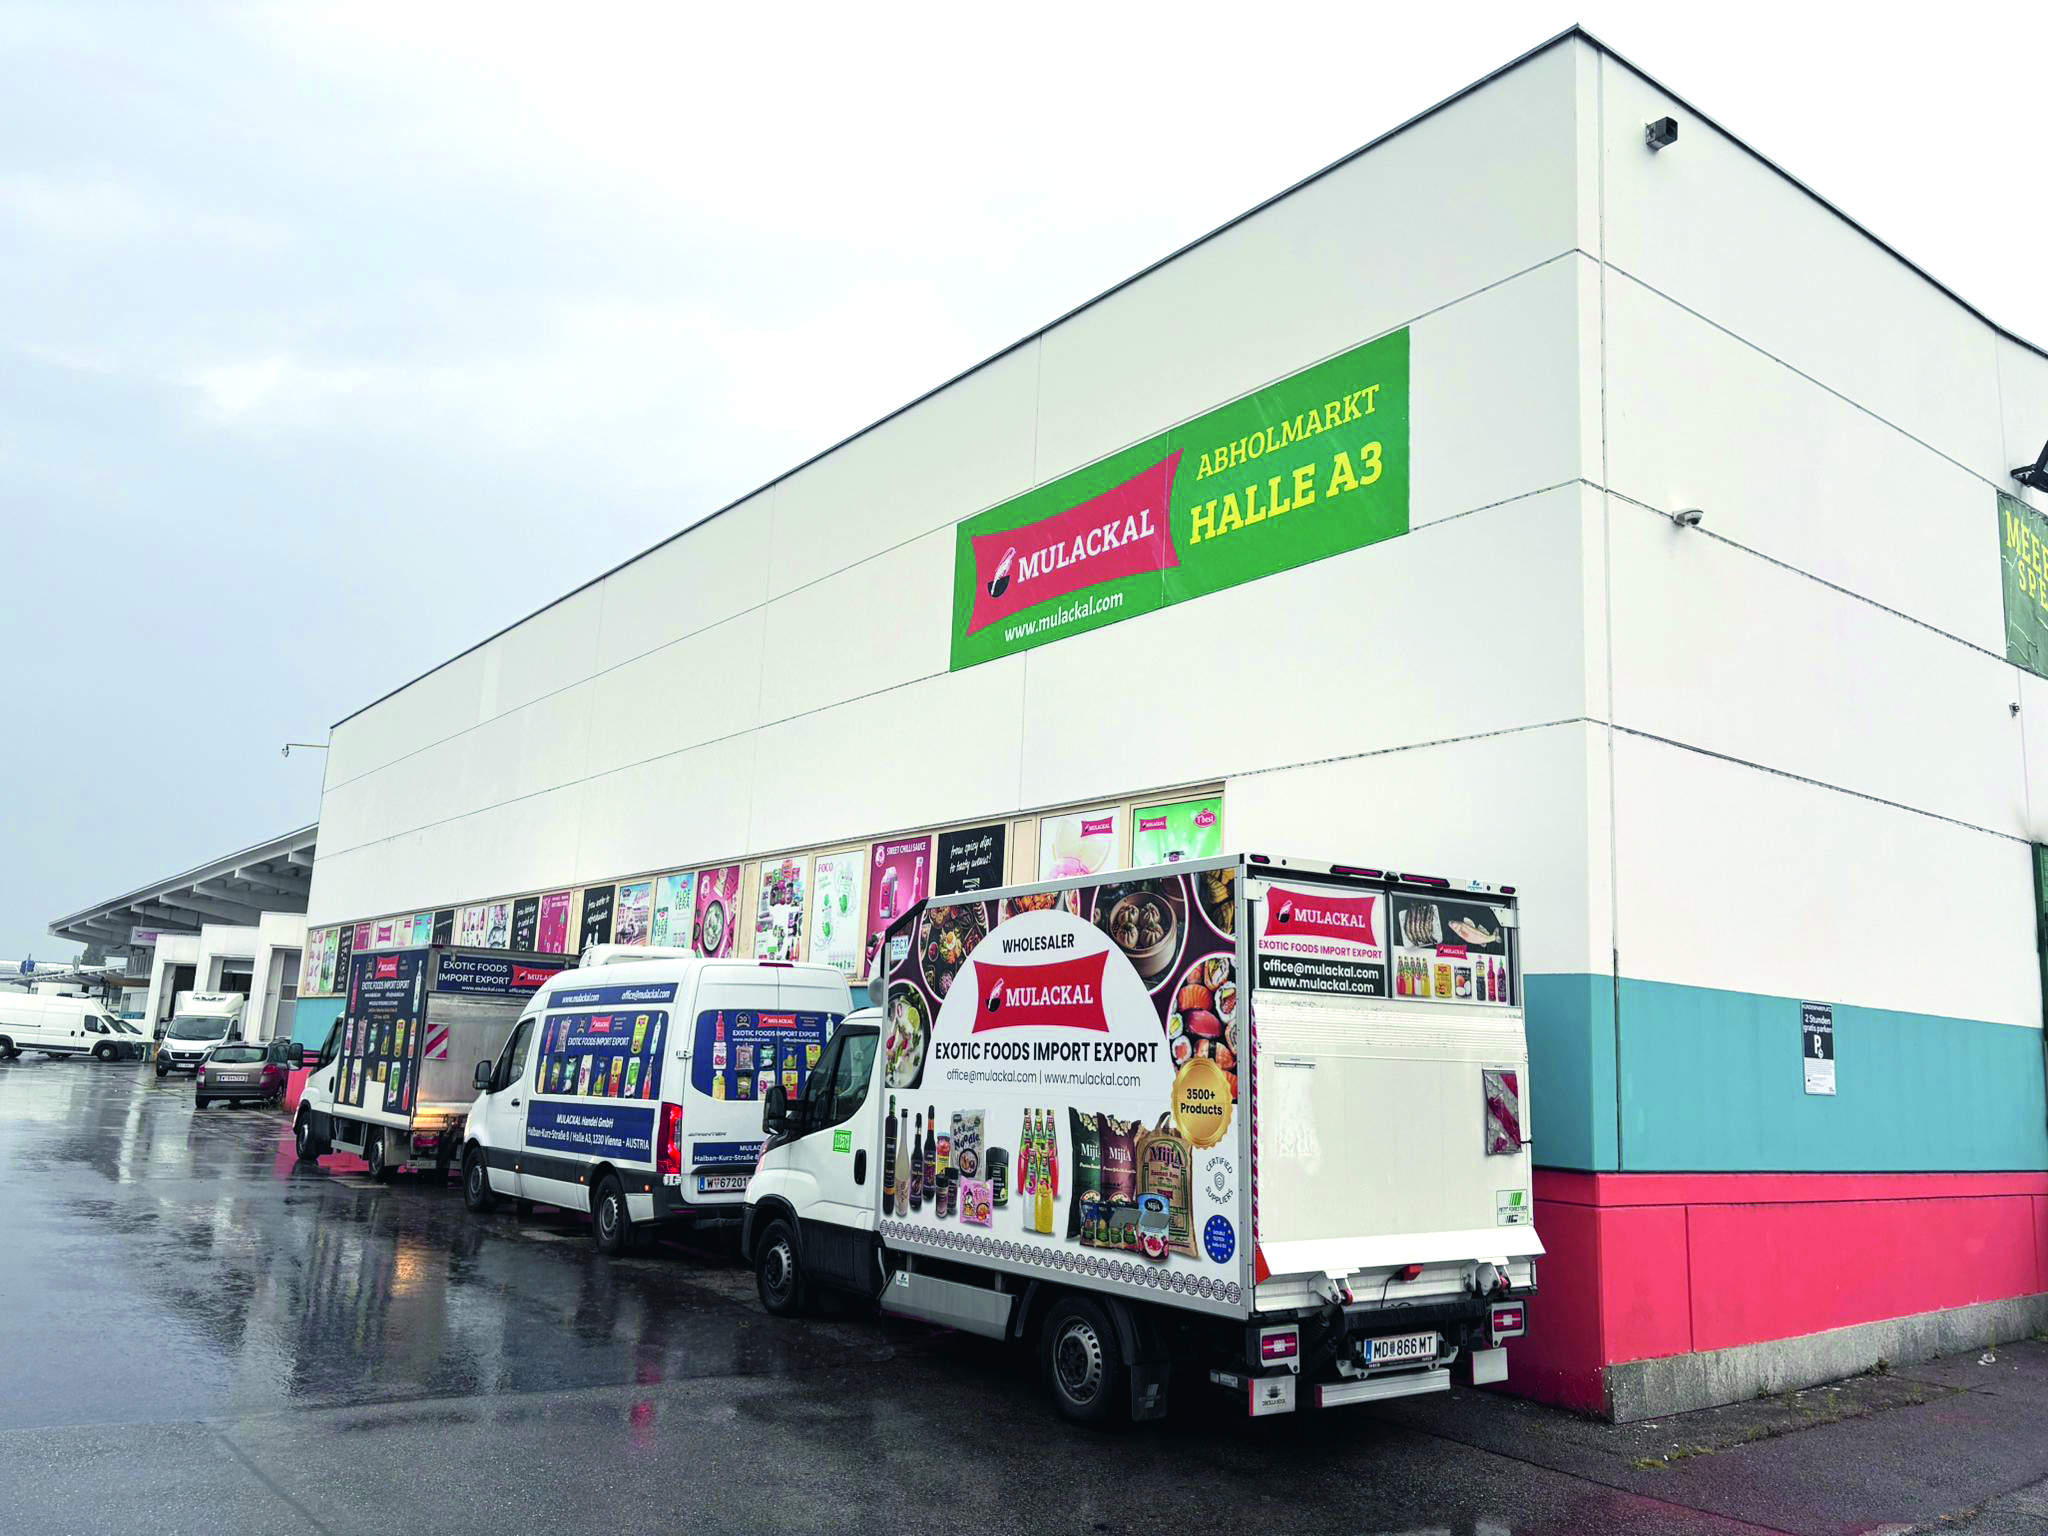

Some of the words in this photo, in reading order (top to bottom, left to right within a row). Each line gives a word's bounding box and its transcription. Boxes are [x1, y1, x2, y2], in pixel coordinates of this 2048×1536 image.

[1196, 384, 1379, 480] ABHOLMARKT
[1190, 467, 1315, 545] HALLE
[1326, 441, 1383, 498] A3
[1017, 509, 1154, 584] MULACKAL
[1004, 592, 1123, 642] www.mulackal.com
[887, 846, 899, 855] SWEET
[913, 842, 926, 851] SAUCE
[1294, 908, 1366, 928] MULACKAL
[1003, 934, 1075, 953] WHOLESALER
[1259, 940, 1289, 951] EXOTIC
[1291, 943, 1319, 954] FOODS
[1320, 945, 1350, 956] IMPORT
[1352, 948, 1382, 959] EXPORT
[443, 960, 476, 971] EXOTIC
[477, 963, 508, 973] FOODS
[1263, 959, 1379, 979] office@mulackal.com
[439, 973, 474, 983] IMPORT
[476, 975, 509, 985] EXPORT
[1269, 976, 1374, 993] www.mulackal.com
[1006, 984, 1093, 1007] MULACKAL
[1805, 1014, 1809, 1023] 2
[1809, 1014, 1831, 1025] Stunden
[1803, 1025, 1816, 1033] gratis
[1817, 1026, 1832, 1034] parken
[612, 1037, 630, 1045] EXPORT
[1813, 1034, 1822, 1054] P
[935, 1043, 981, 1060] EXOTIC
[984, 1043, 1030, 1060] FOODS
[1033, 1043, 1090, 1061] IMPORT
[1094, 1043, 1158, 1062] EXPORT
[947, 1069, 1037, 1084] office@mulackal.com
[1044, 1072, 1141, 1087] www.mulackal.com
[1186, 1089, 1215, 1100] 3500+
[1180, 1103, 1223, 1116] Products
[556, 1114, 581, 1125] MULACKAL
[582, 1116, 598, 1127] Handel
[598, 1118, 614, 1128] GmbH
[573, 1133, 585, 1143] Halle
[593, 1134, 604, 1145] 1230
[605, 1136, 622, 1147] Vienna
[626, 1139, 650, 1150] AUSTRIA
[694, 1154, 754, 1162] Halban-Kurz-Straße
[1081, 1143, 1100, 1160] Miji
[1206, 1156, 1233, 1174] CERTIFIED
[707, 1178, 713, 1188] W
[720, 1177, 752, 1188] 67201
[1206, 1186, 1233, 1205] SUPPLIERS
[1374, 1341, 1388, 1358] MD
[1397, 1338, 1416, 1355] 866
[1420, 1336, 1432, 1353] MT
